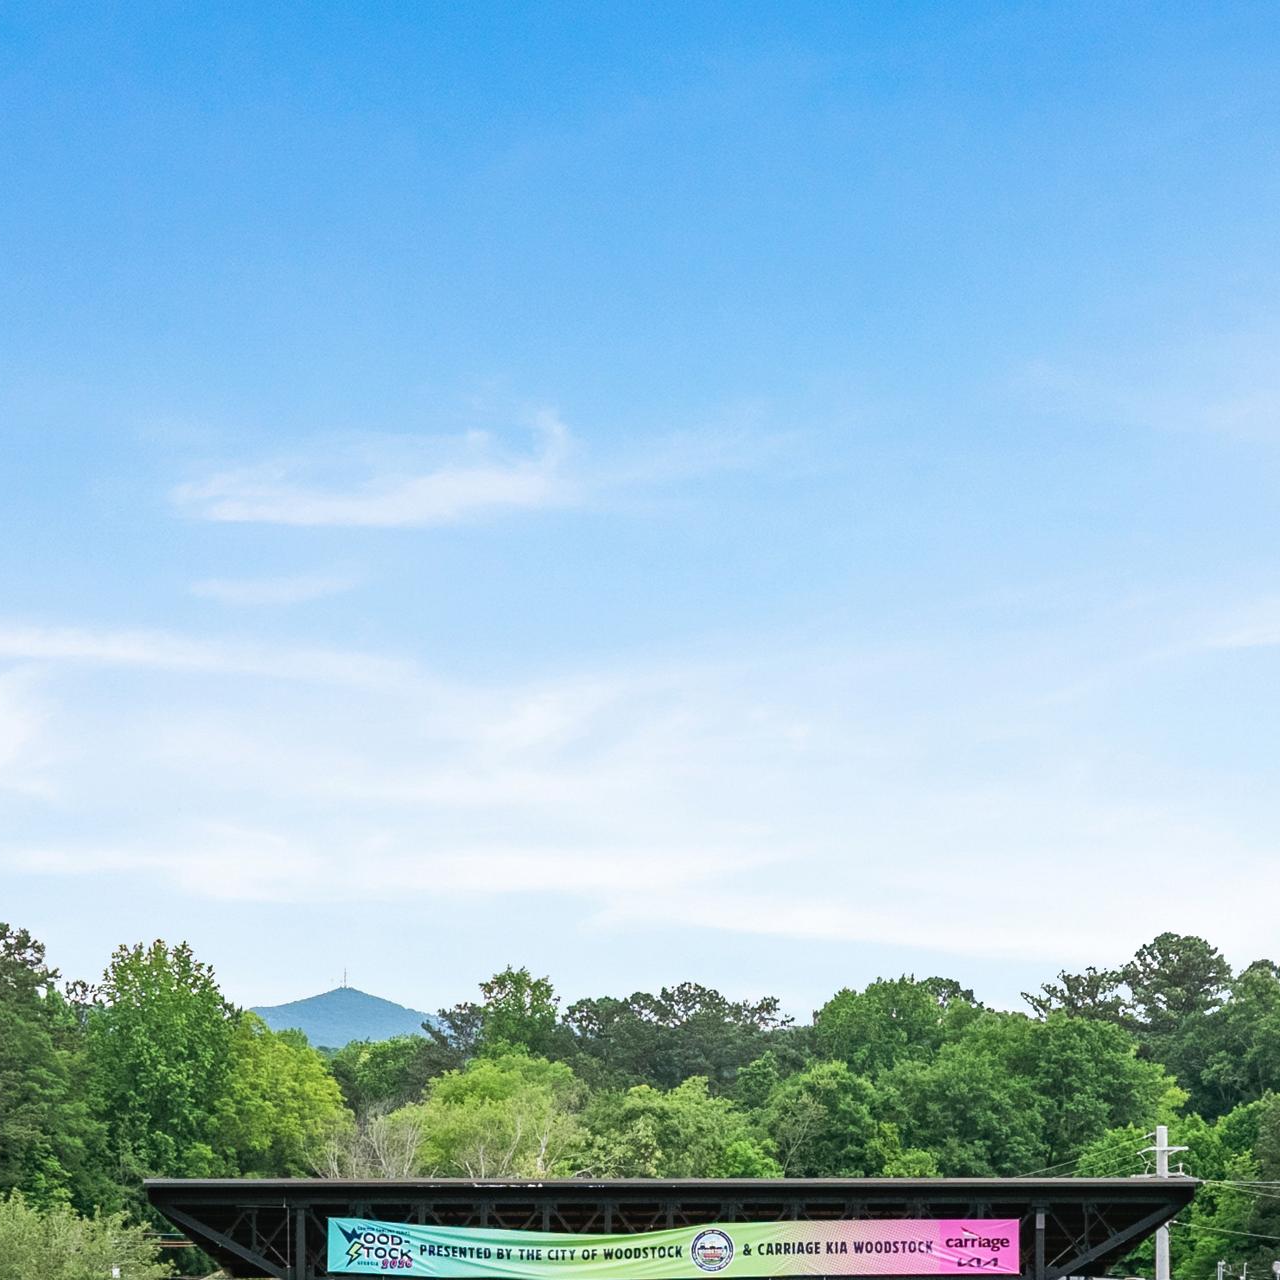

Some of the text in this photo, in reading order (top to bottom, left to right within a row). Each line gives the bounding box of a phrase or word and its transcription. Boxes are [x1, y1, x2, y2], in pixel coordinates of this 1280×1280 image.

[419, 1240, 934, 1261] PRESENTED BY THE CITY OF WOODSTOCK & CARRIAGE KIA WOODSTOCK
[945, 1237, 1010, 1252] carriage
[957, 1257, 999, 1268] KIA
